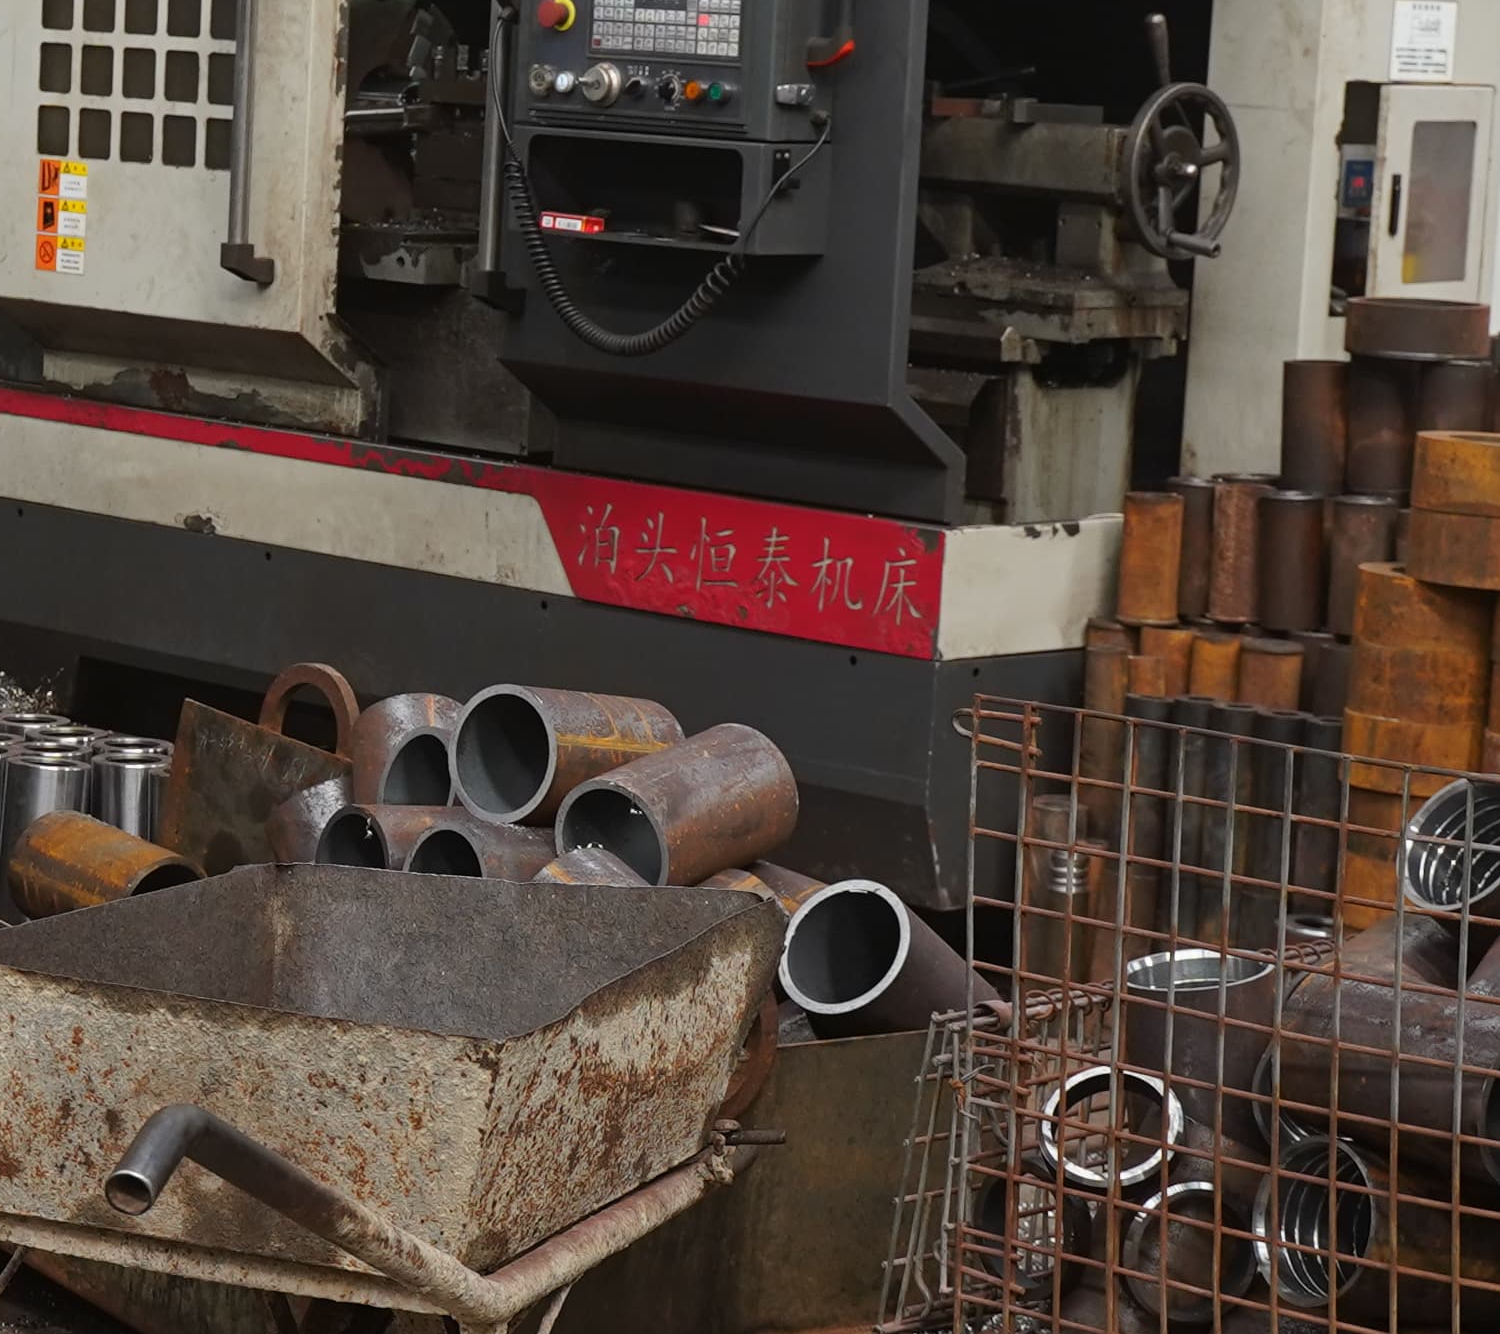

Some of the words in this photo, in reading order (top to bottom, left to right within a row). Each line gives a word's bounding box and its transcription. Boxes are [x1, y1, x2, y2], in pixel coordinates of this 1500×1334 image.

[577, 503, 924, 625] 泊头恒泰机床
